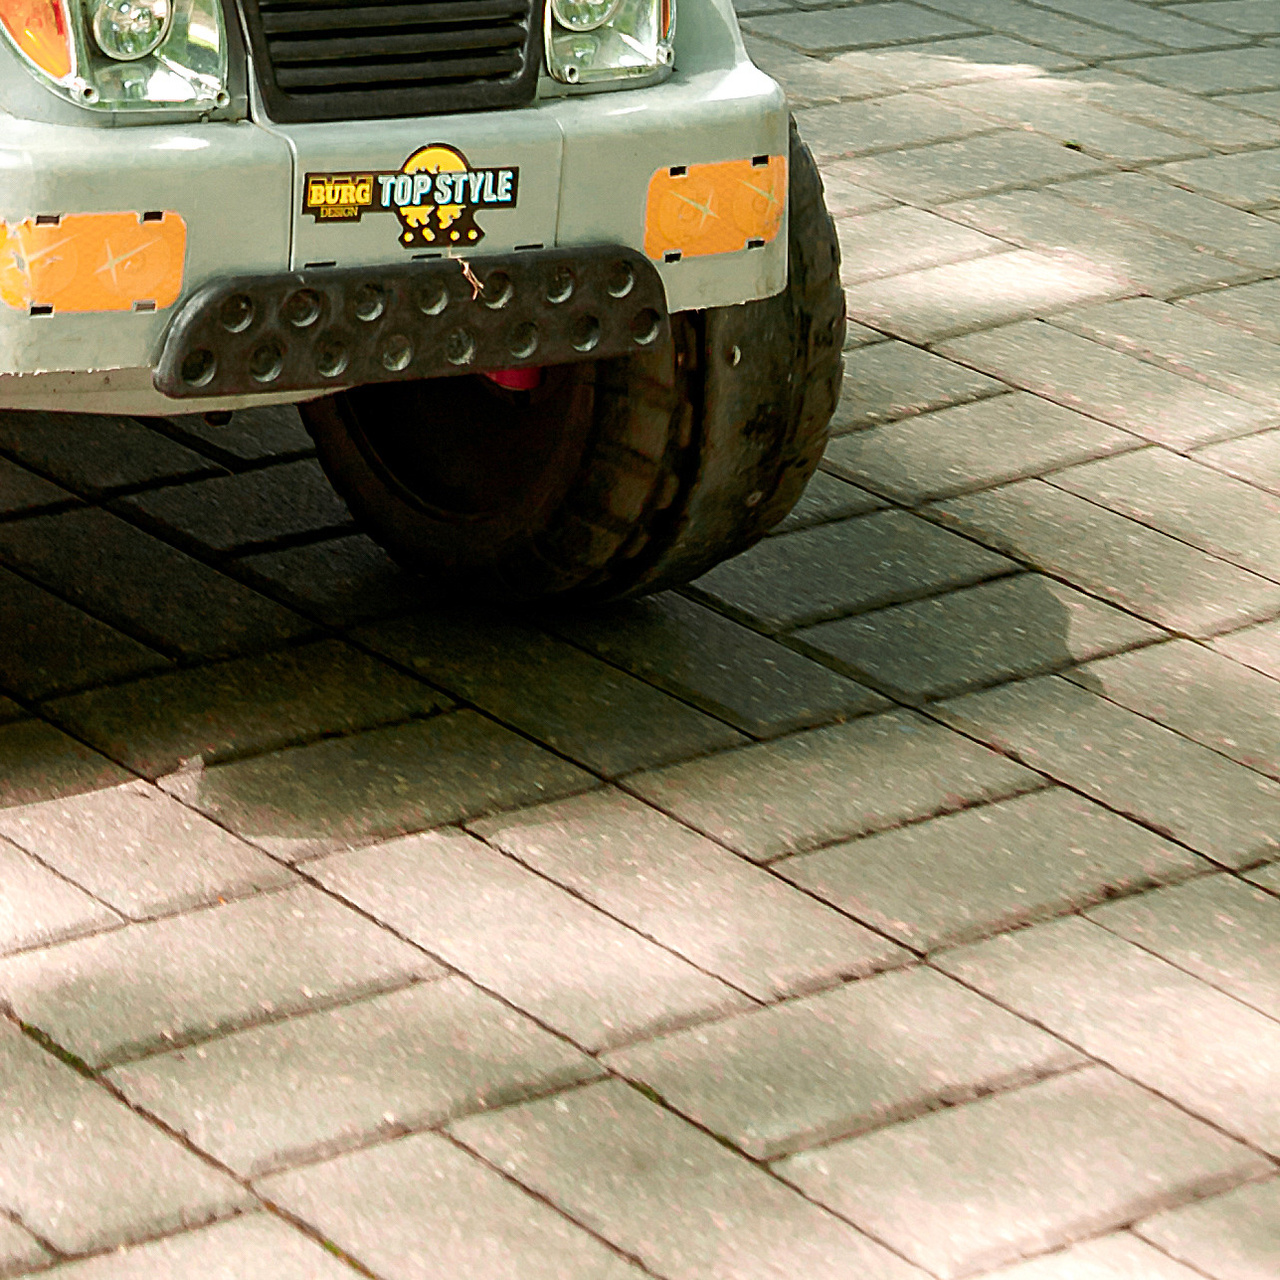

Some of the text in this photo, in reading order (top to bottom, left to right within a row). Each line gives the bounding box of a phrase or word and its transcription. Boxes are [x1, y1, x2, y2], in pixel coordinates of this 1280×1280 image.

[309, 182, 371, 205] BURG
[377, 169, 514, 207] TOP STYLE
[319, 206, 359, 218] DESIGN
